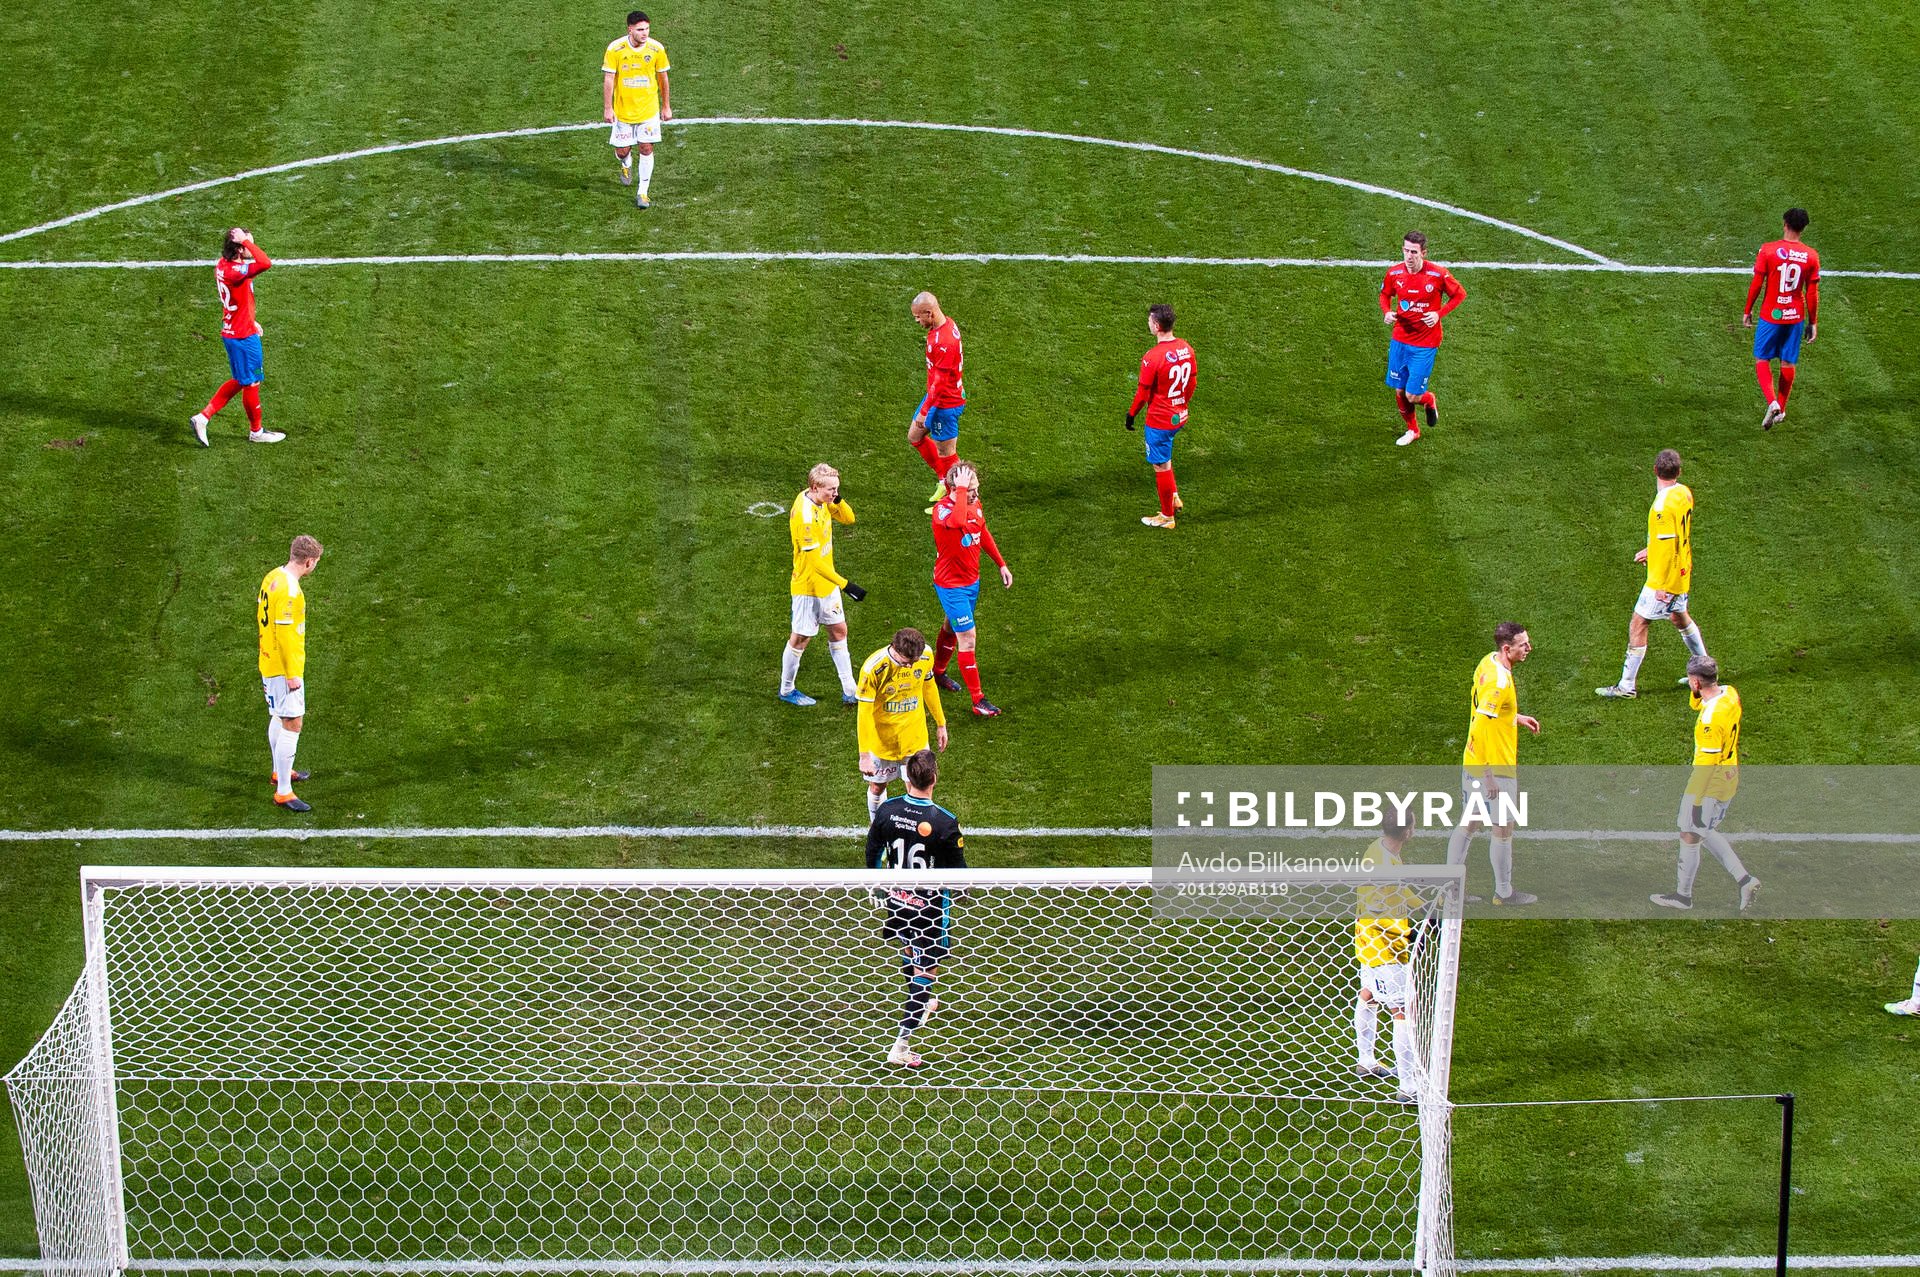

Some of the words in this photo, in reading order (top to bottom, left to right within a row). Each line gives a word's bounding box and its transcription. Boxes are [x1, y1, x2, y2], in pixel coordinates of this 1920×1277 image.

[1777, 262, 1801, 293] 19
[1168, 362, 1192, 398] 29
[892, 838, 928, 869] 16
